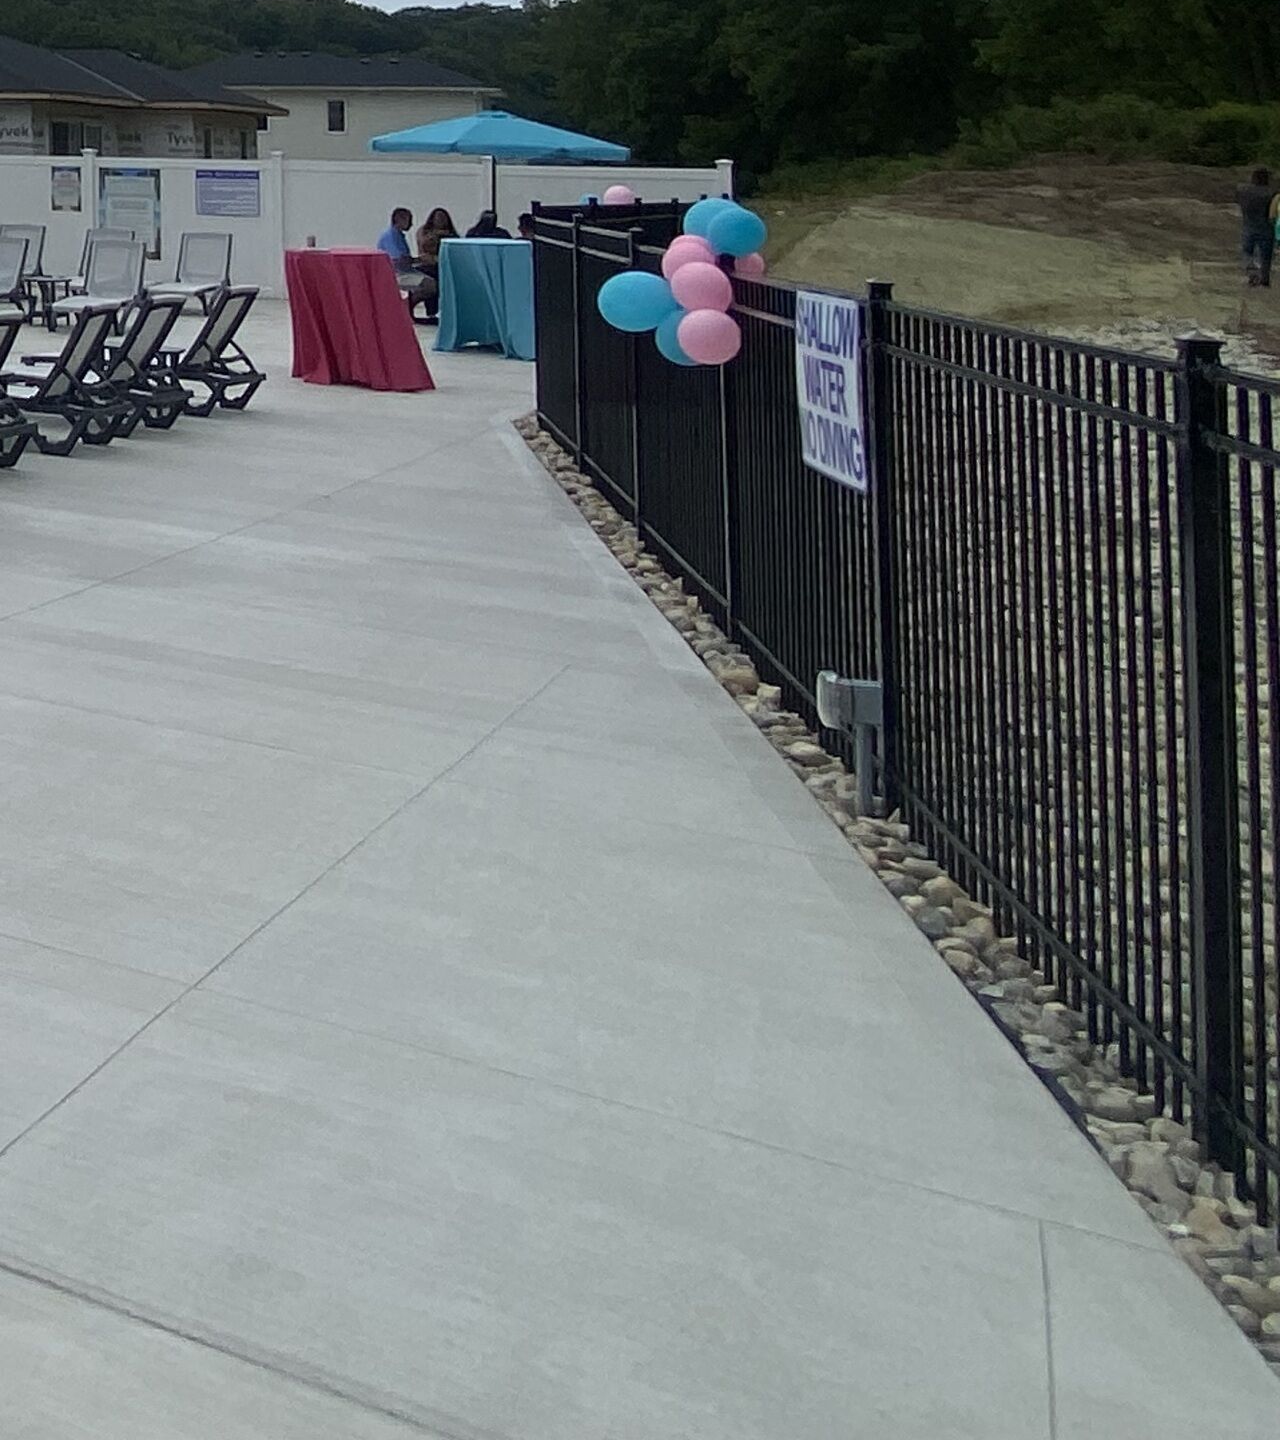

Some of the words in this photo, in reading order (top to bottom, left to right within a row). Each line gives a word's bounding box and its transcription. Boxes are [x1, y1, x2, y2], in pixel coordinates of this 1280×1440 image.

[797, 297, 857, 359] SHALLOW
[803, 352, 848, 418] WATER
[816, 414, 864, 481] DIVING
